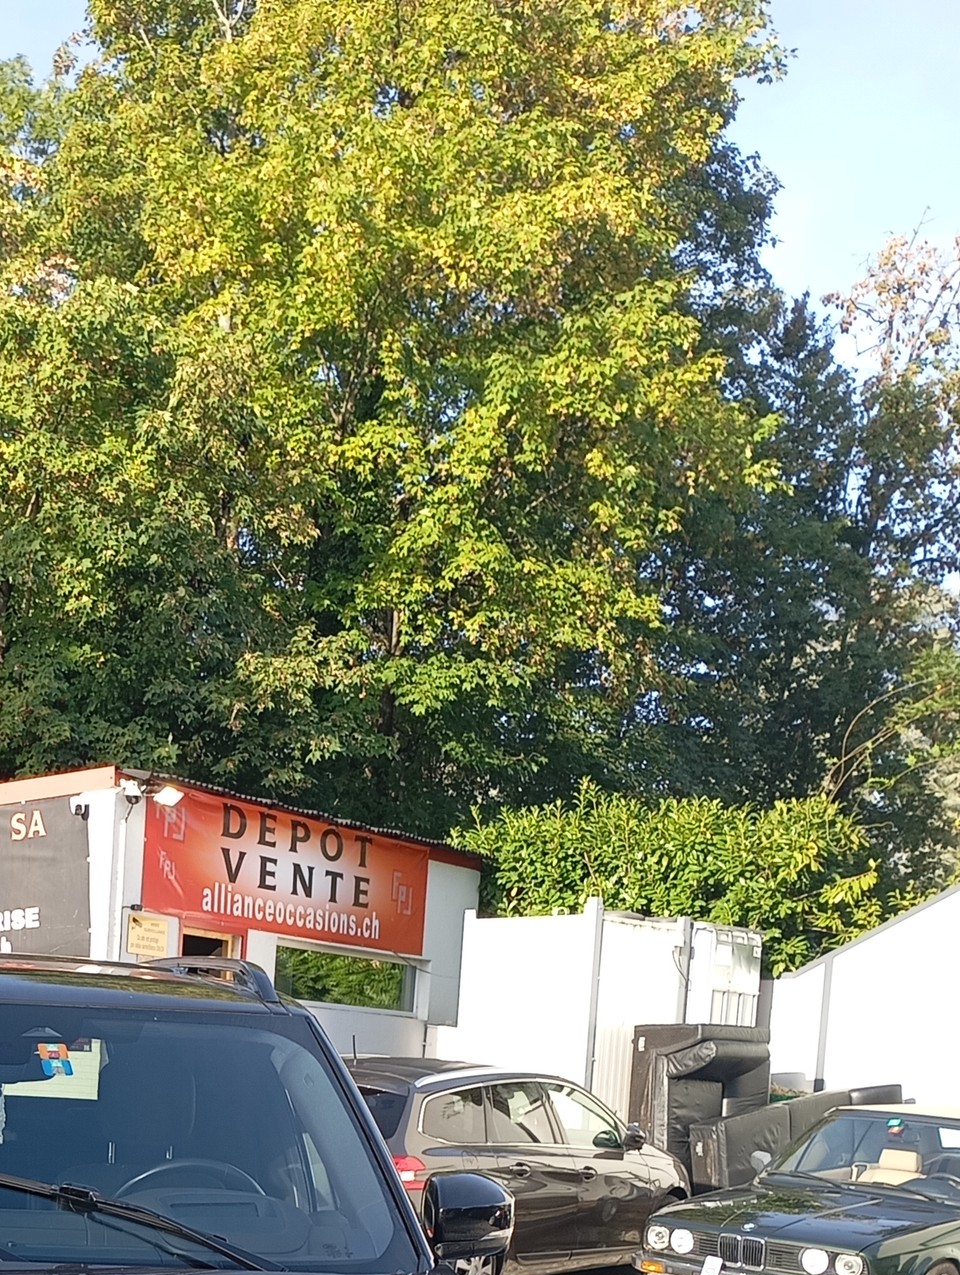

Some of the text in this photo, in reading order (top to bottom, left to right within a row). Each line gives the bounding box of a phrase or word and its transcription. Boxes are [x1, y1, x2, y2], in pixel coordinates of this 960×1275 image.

[11, 809, 48, 842] SA
[221, 846, 371, 909] VENTE
[201, 881, 381, 941] allianceoccasions.ch
